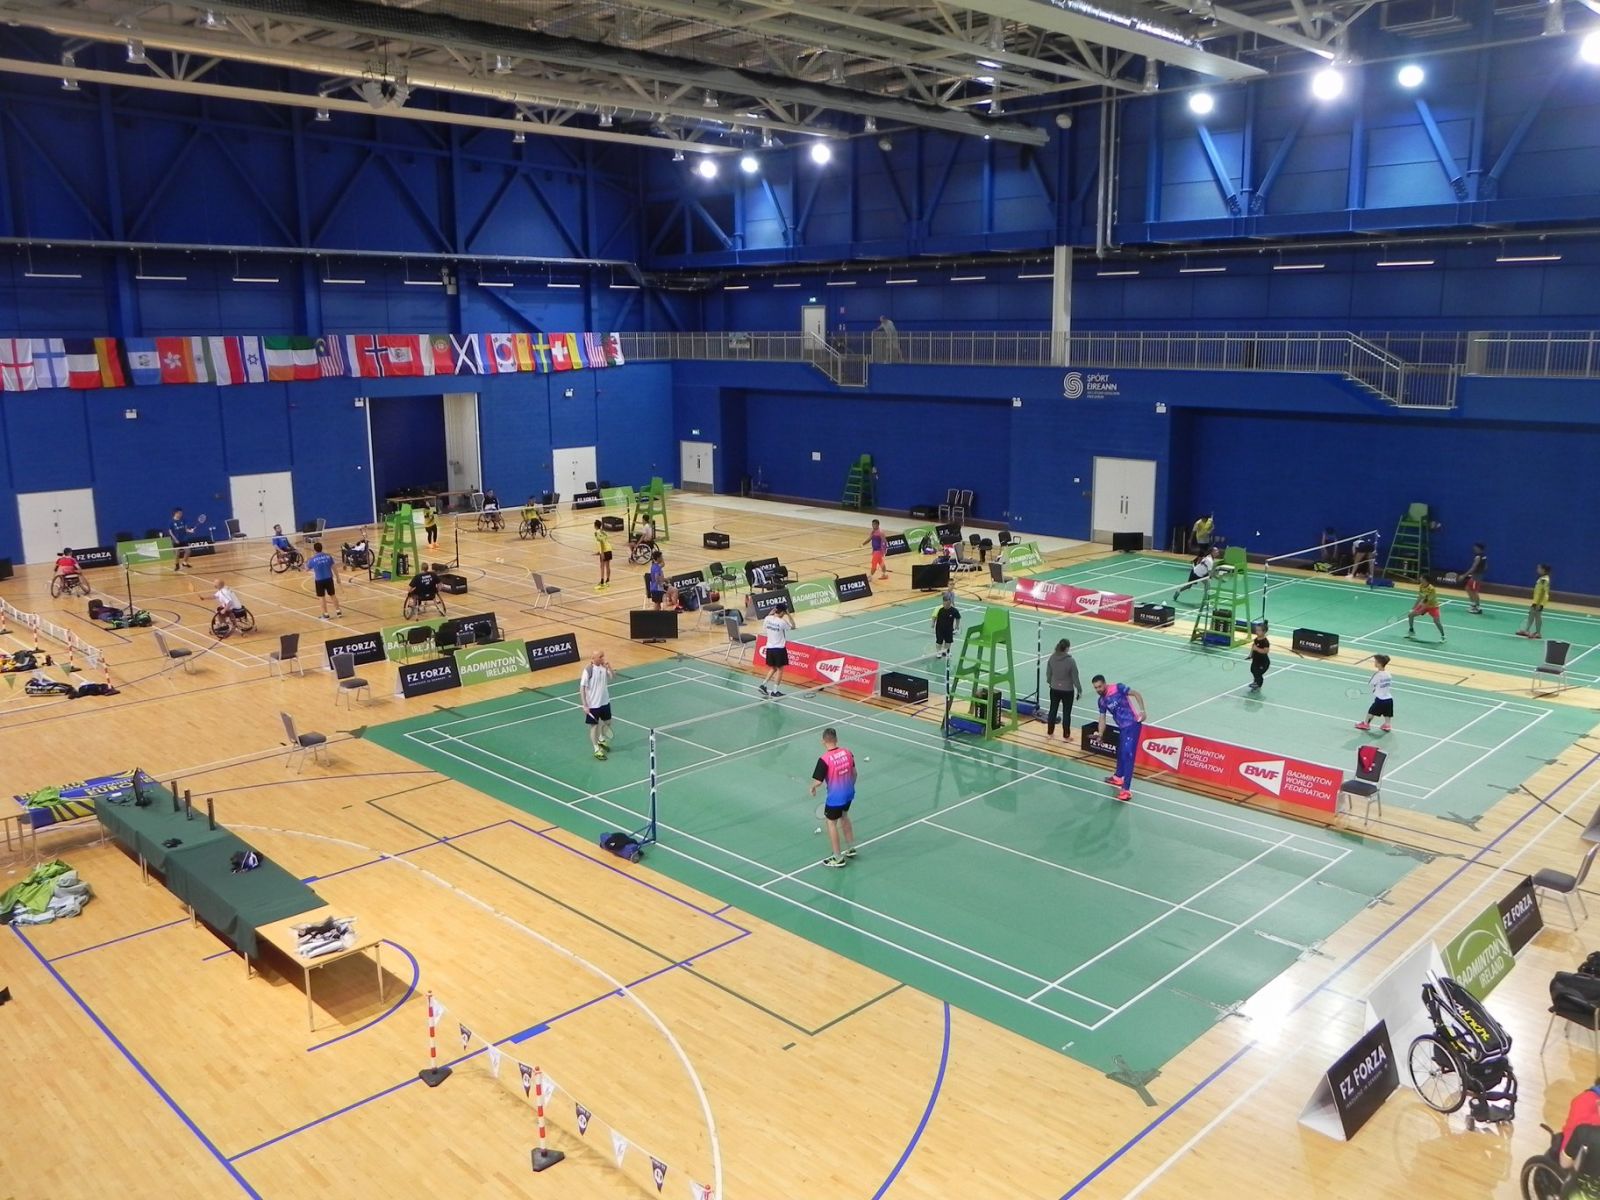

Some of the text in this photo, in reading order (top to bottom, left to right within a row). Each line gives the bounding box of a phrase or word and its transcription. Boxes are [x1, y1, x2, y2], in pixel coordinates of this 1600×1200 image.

[87, 551, 112, 560] FORZA
[839, 584, 847, 592] FZ
[847, 580, 865, 590] FORZA
[766, 596, 787, 606] FORZA
[792, 591, 828, 603] BADMINTON
[332, 646, 343, 655] FZ
[346, 640, 376, 653] FORZA
[532, 648, 543, 657] FZ
[544, 642, 572, 654] FORZA
[461, 655, 516, 675] BADMINTON
[486, 664, 518, 678] IRELAND
[819, 662, 840, 673] BWF
[407, 672, 419, 683] FZ
[420, 666, 452, 680] FORZA
[1146, 741, 1178, 756] BWF
[1184, 745, 1226, 760] BADMINTON
[1183, 751, 1209, 763] WORLD
[1182, 758, 1225, 774] FEDERATION
[1244, 765, 1280, 780] BWF
[1285, 776, 1314, 788] WORLD
[1286, 769, 1333, 786] BADMINTON
[1284, 783, 1331, 800] FEDERATION
[1502, 893, 1533, 930] FZ FORZA
[1456, 939, 1501, 988] BADMINTON
[1478, 955, 1505, 988] IRELAND
[1339, 1075, 1354, 1100] FZ
[1352, 1045, 1387, 1087] FORZA
